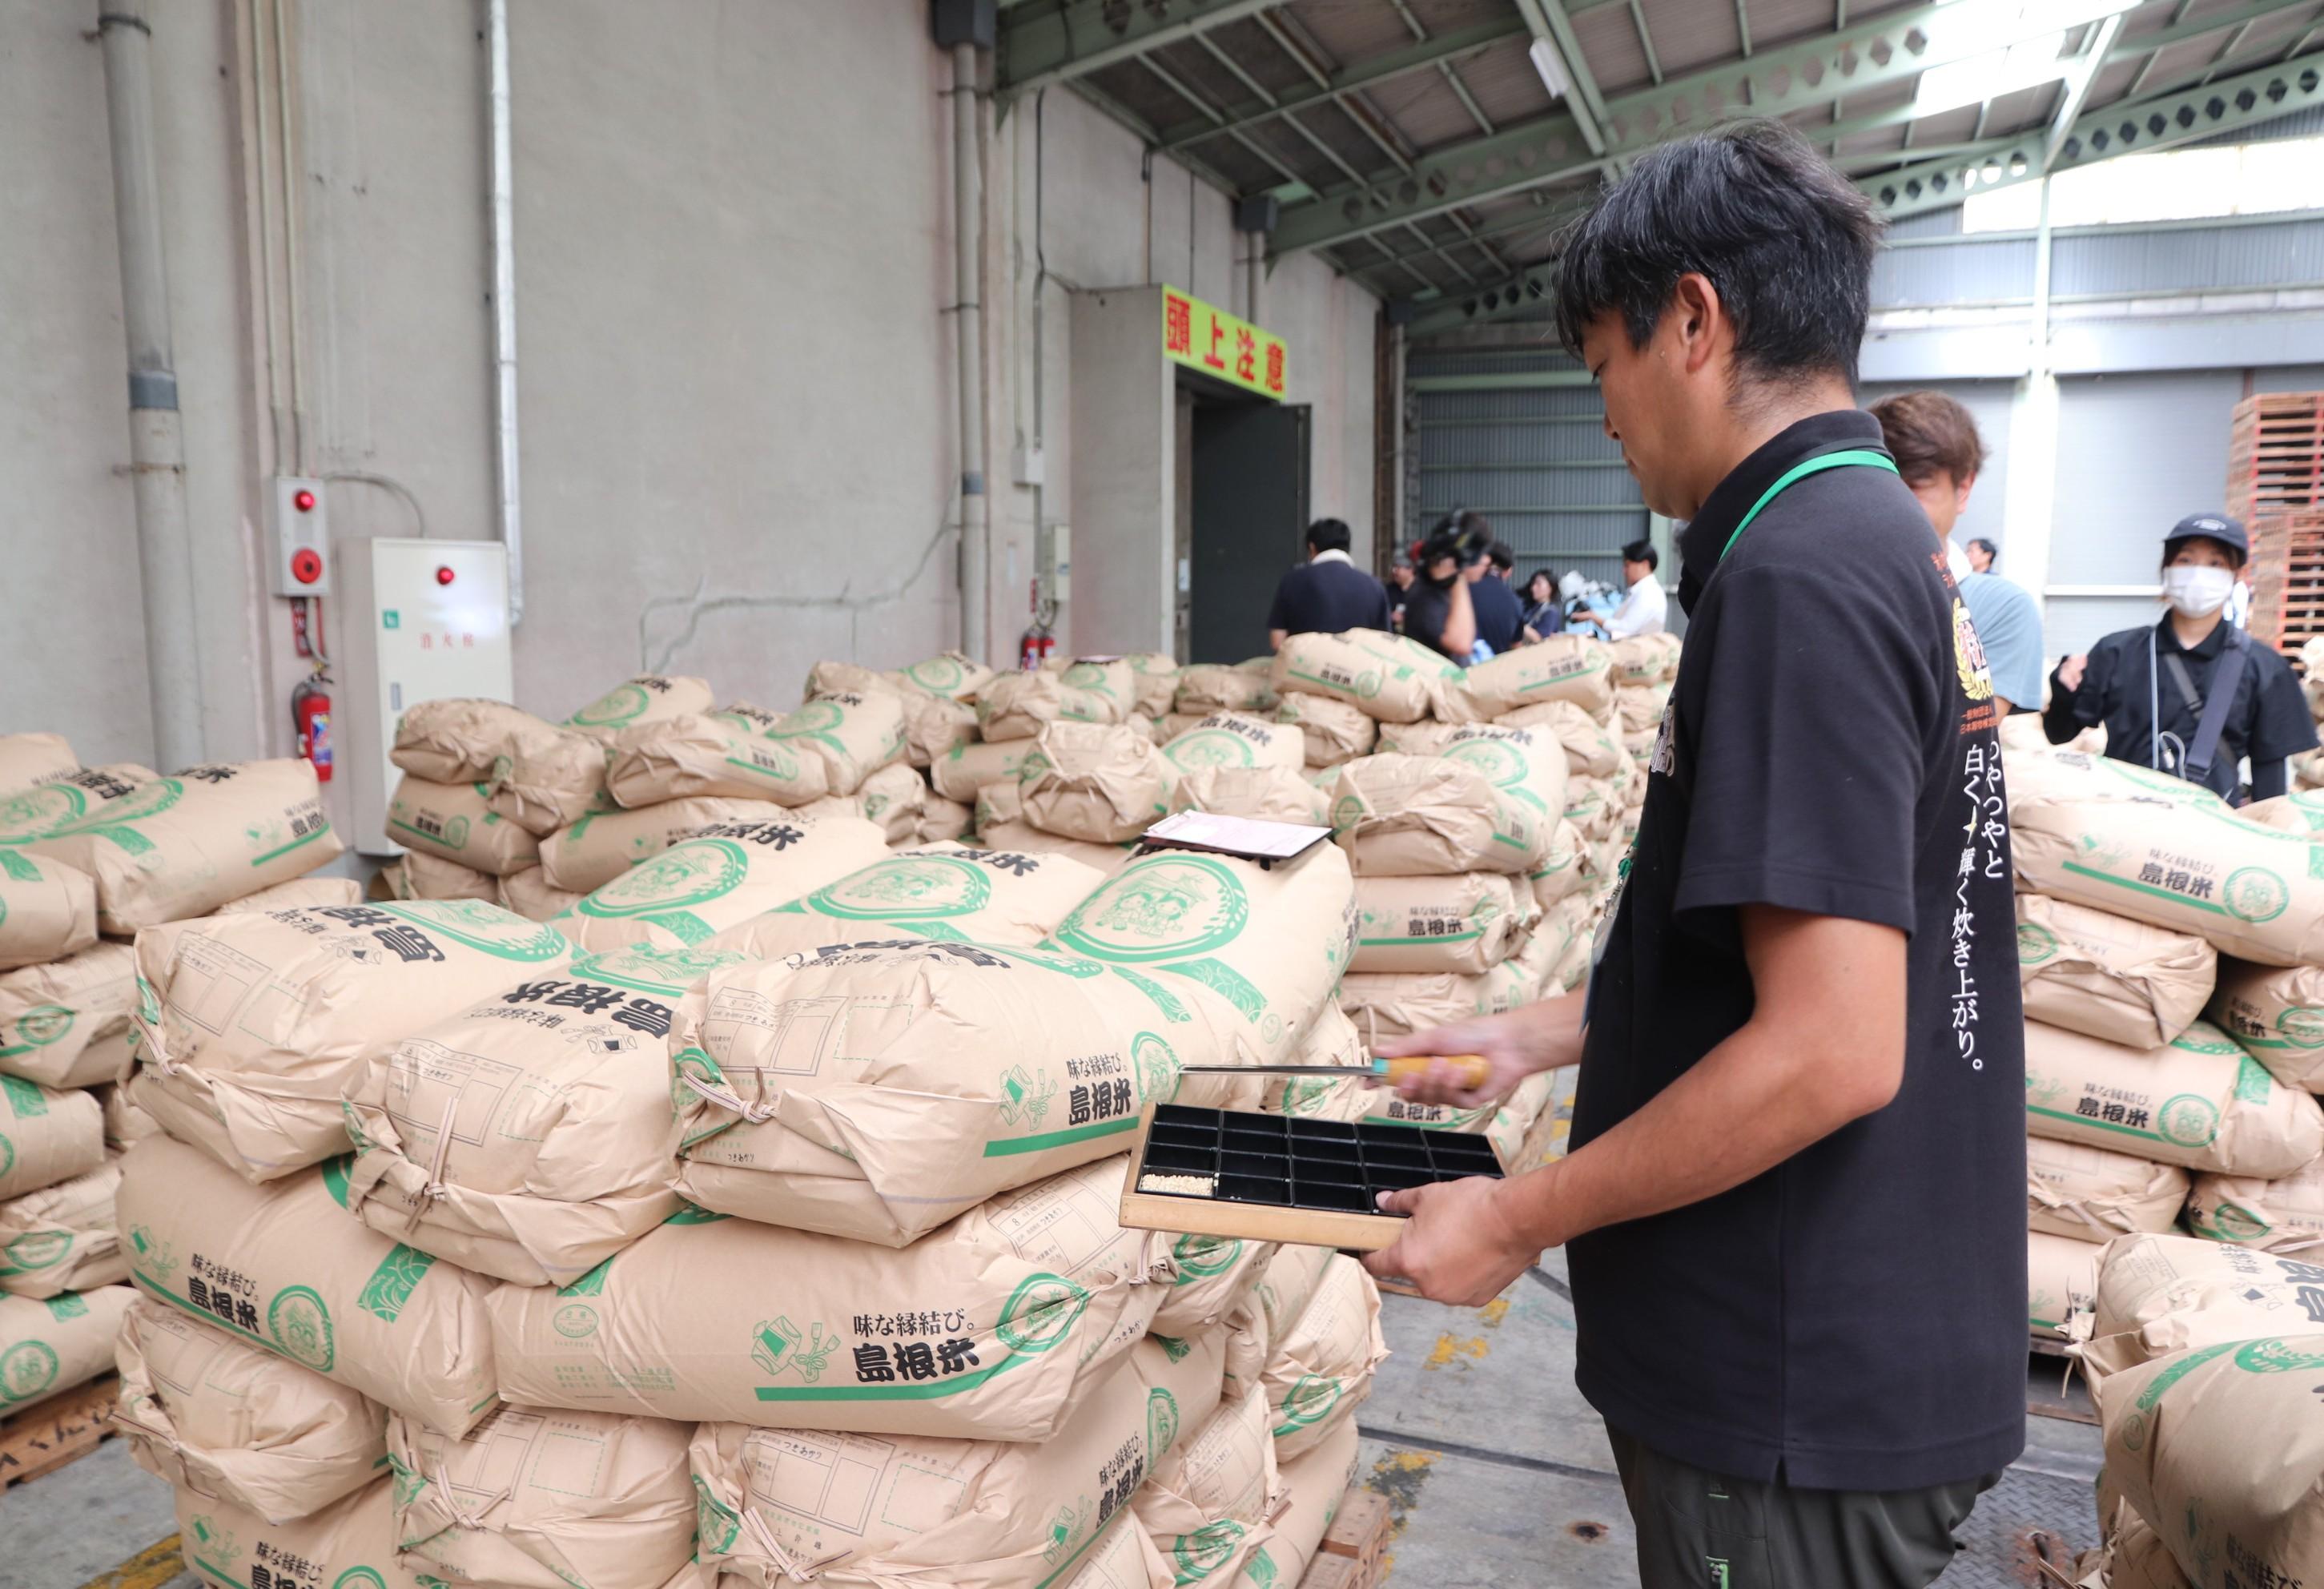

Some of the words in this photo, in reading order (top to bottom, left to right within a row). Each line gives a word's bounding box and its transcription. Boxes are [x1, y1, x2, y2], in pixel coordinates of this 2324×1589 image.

[1166, 293, 1285, 393] 頭上注意
[1981, 740, 2007, 879] つやつやと
[2137, 863, 2215, 899] 島根米
[1408, 919, 1464, 937] 島根米
[1065, 1052, 1128, 1080] 味な縁結び。
[1068, 1077, 1132, 1126] 島根米
[1386, 1101, 1441, 1121] 島根米
[2076, 1097, 2149, 1128] 島根米
[191, 1253, 259, 1301] 味な縁結び。
[187, 1275, 260, 1334] 島根米
[853, 1307, 975, 1338] 味な縁結び。
[852, 1337, 980, 1383] 島根米
[1096, 1454, 1144, 1530] 島根米
[255, 1541, 326, 1585] 味な縁結び。
